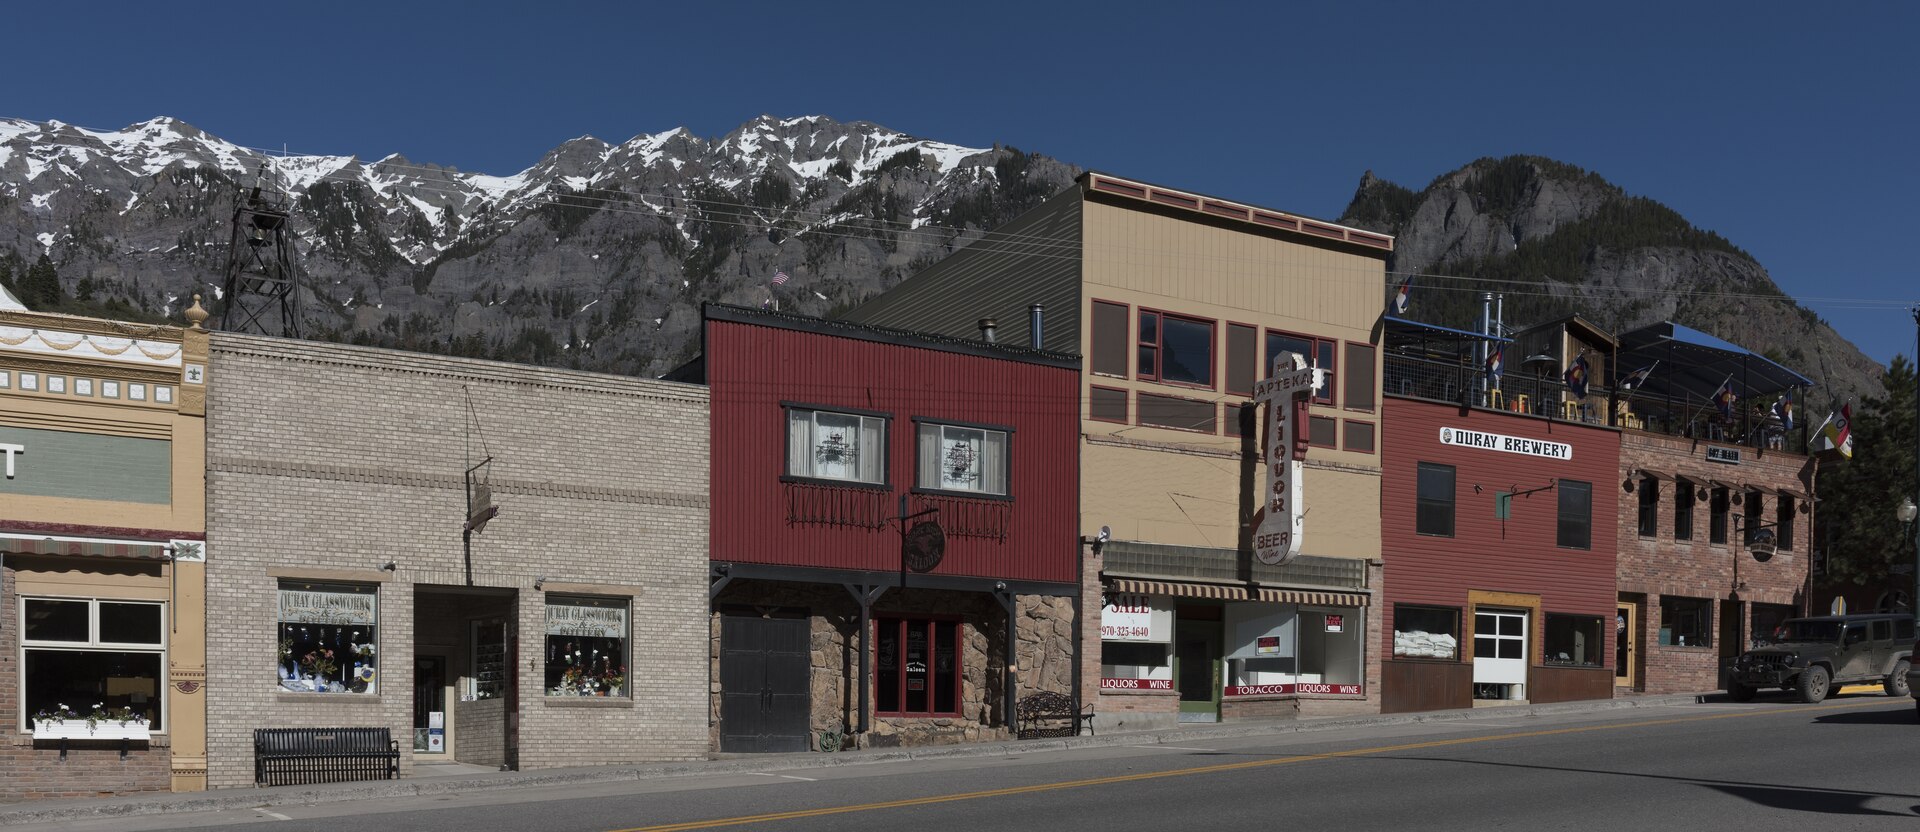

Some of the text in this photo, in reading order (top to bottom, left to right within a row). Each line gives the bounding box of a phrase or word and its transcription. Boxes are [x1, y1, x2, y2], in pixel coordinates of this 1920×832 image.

[1257, 373, 1310, 396] APTEKA
[1455, 430, 1567, 458] OURAY BREWERY
[1272, 404, 1286, 513] LIQUOR
[1257, 531, 1288, 549] BEER
[1261, 549, 1280, 560] Wine
[280, 591, 371, 613] OURAY GLASSWORKS
[1111, 593, 1150, 614] SALE
[544, 605, 622, 624] OURAY GLASSWORKS
[560, 626, 608, 637] POTTERY
[1102, 625, 1149, 637] 970-325-4640
[1102, 678, 1171, 689] LIQUORS WINE
[1236, 685, 1283, 695] TOBACCO
[1299, 684, 1358, 694] LIQUORS WINE
